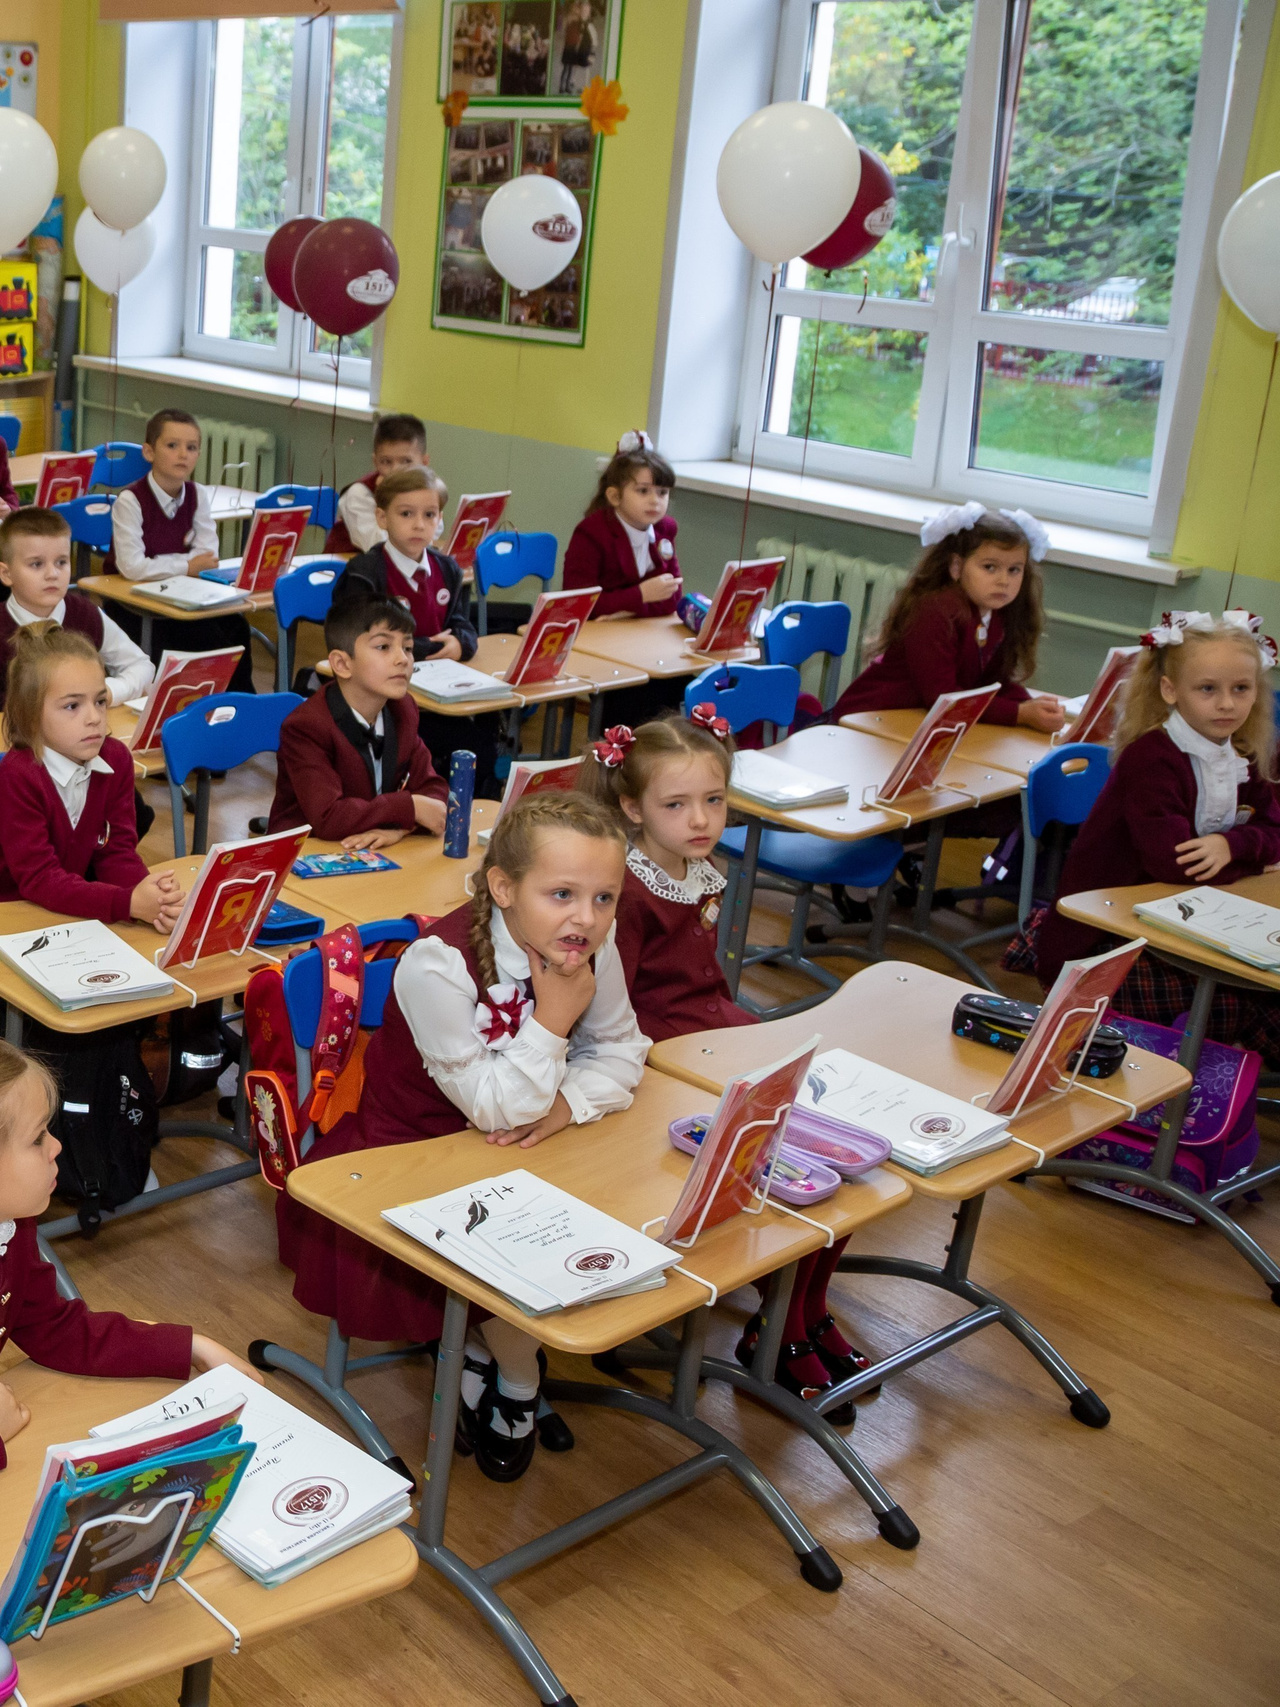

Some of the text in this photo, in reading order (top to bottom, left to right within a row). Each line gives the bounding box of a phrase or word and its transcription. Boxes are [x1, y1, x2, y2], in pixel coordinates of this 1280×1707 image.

[548, 222, 572, 233] 1517
[364, 281, 390, 293] 1517
[263, 545, 283, 568] Я
[540, 632, 564, 658] Я
[216, 890, 256, 929] Я
[727, 1131, 767, 1188] Я
[478, 1182, 522, 1203] +/-
[587, 1257, 607, 1268] 1517
[300, 1492, 323, 1511] 1517
